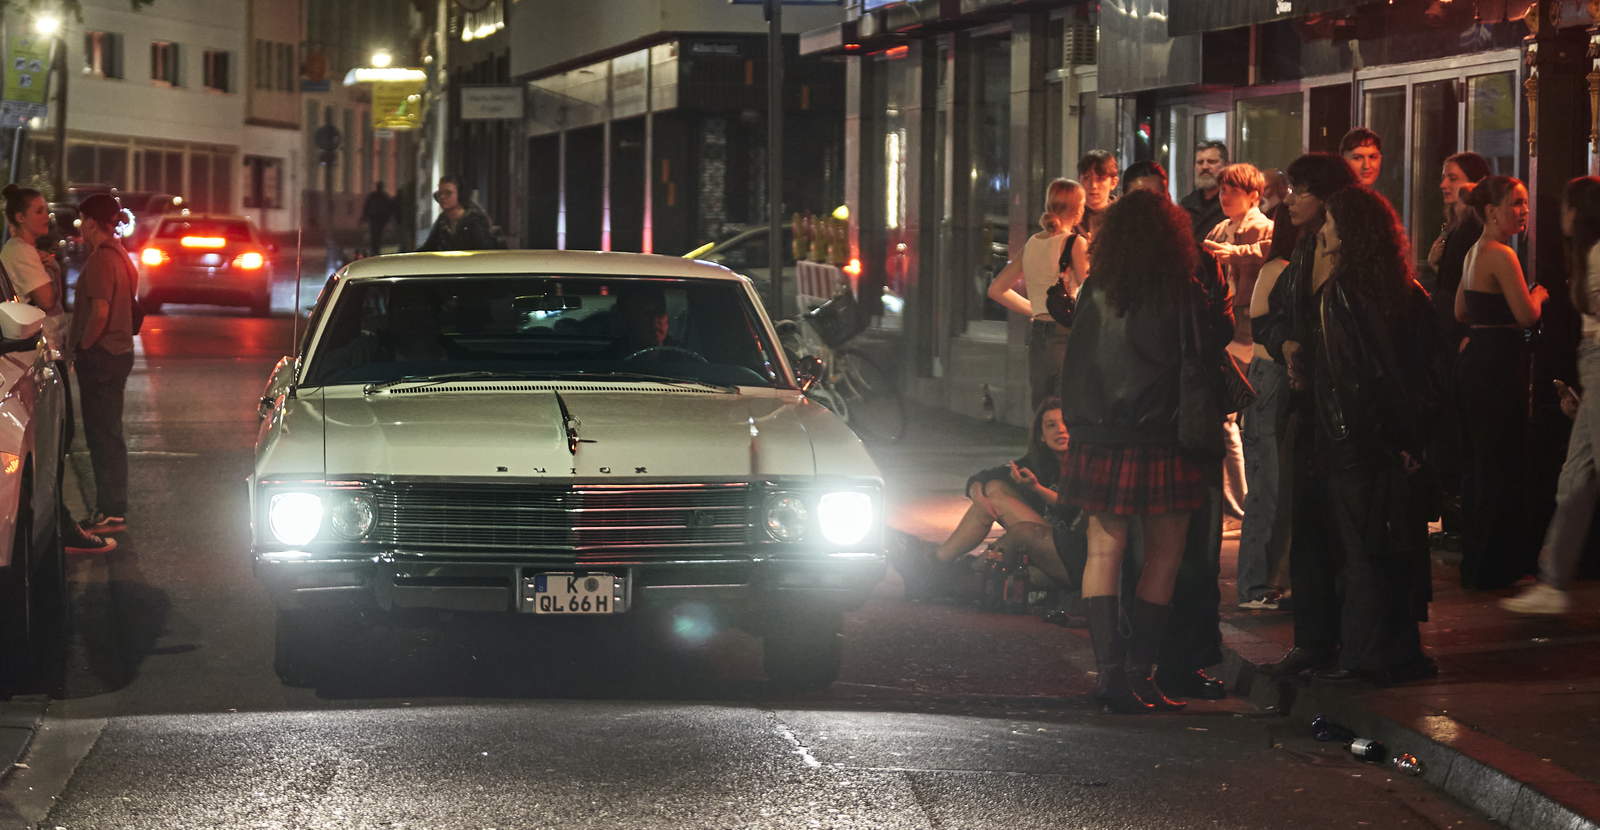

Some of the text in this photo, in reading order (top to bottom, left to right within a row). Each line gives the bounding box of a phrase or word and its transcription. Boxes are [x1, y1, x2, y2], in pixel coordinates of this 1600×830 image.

[496, 466, 649, 475] BUICK
[567, 577, 578, 594] K
[541, 595, 608, 612] QL 66 H
